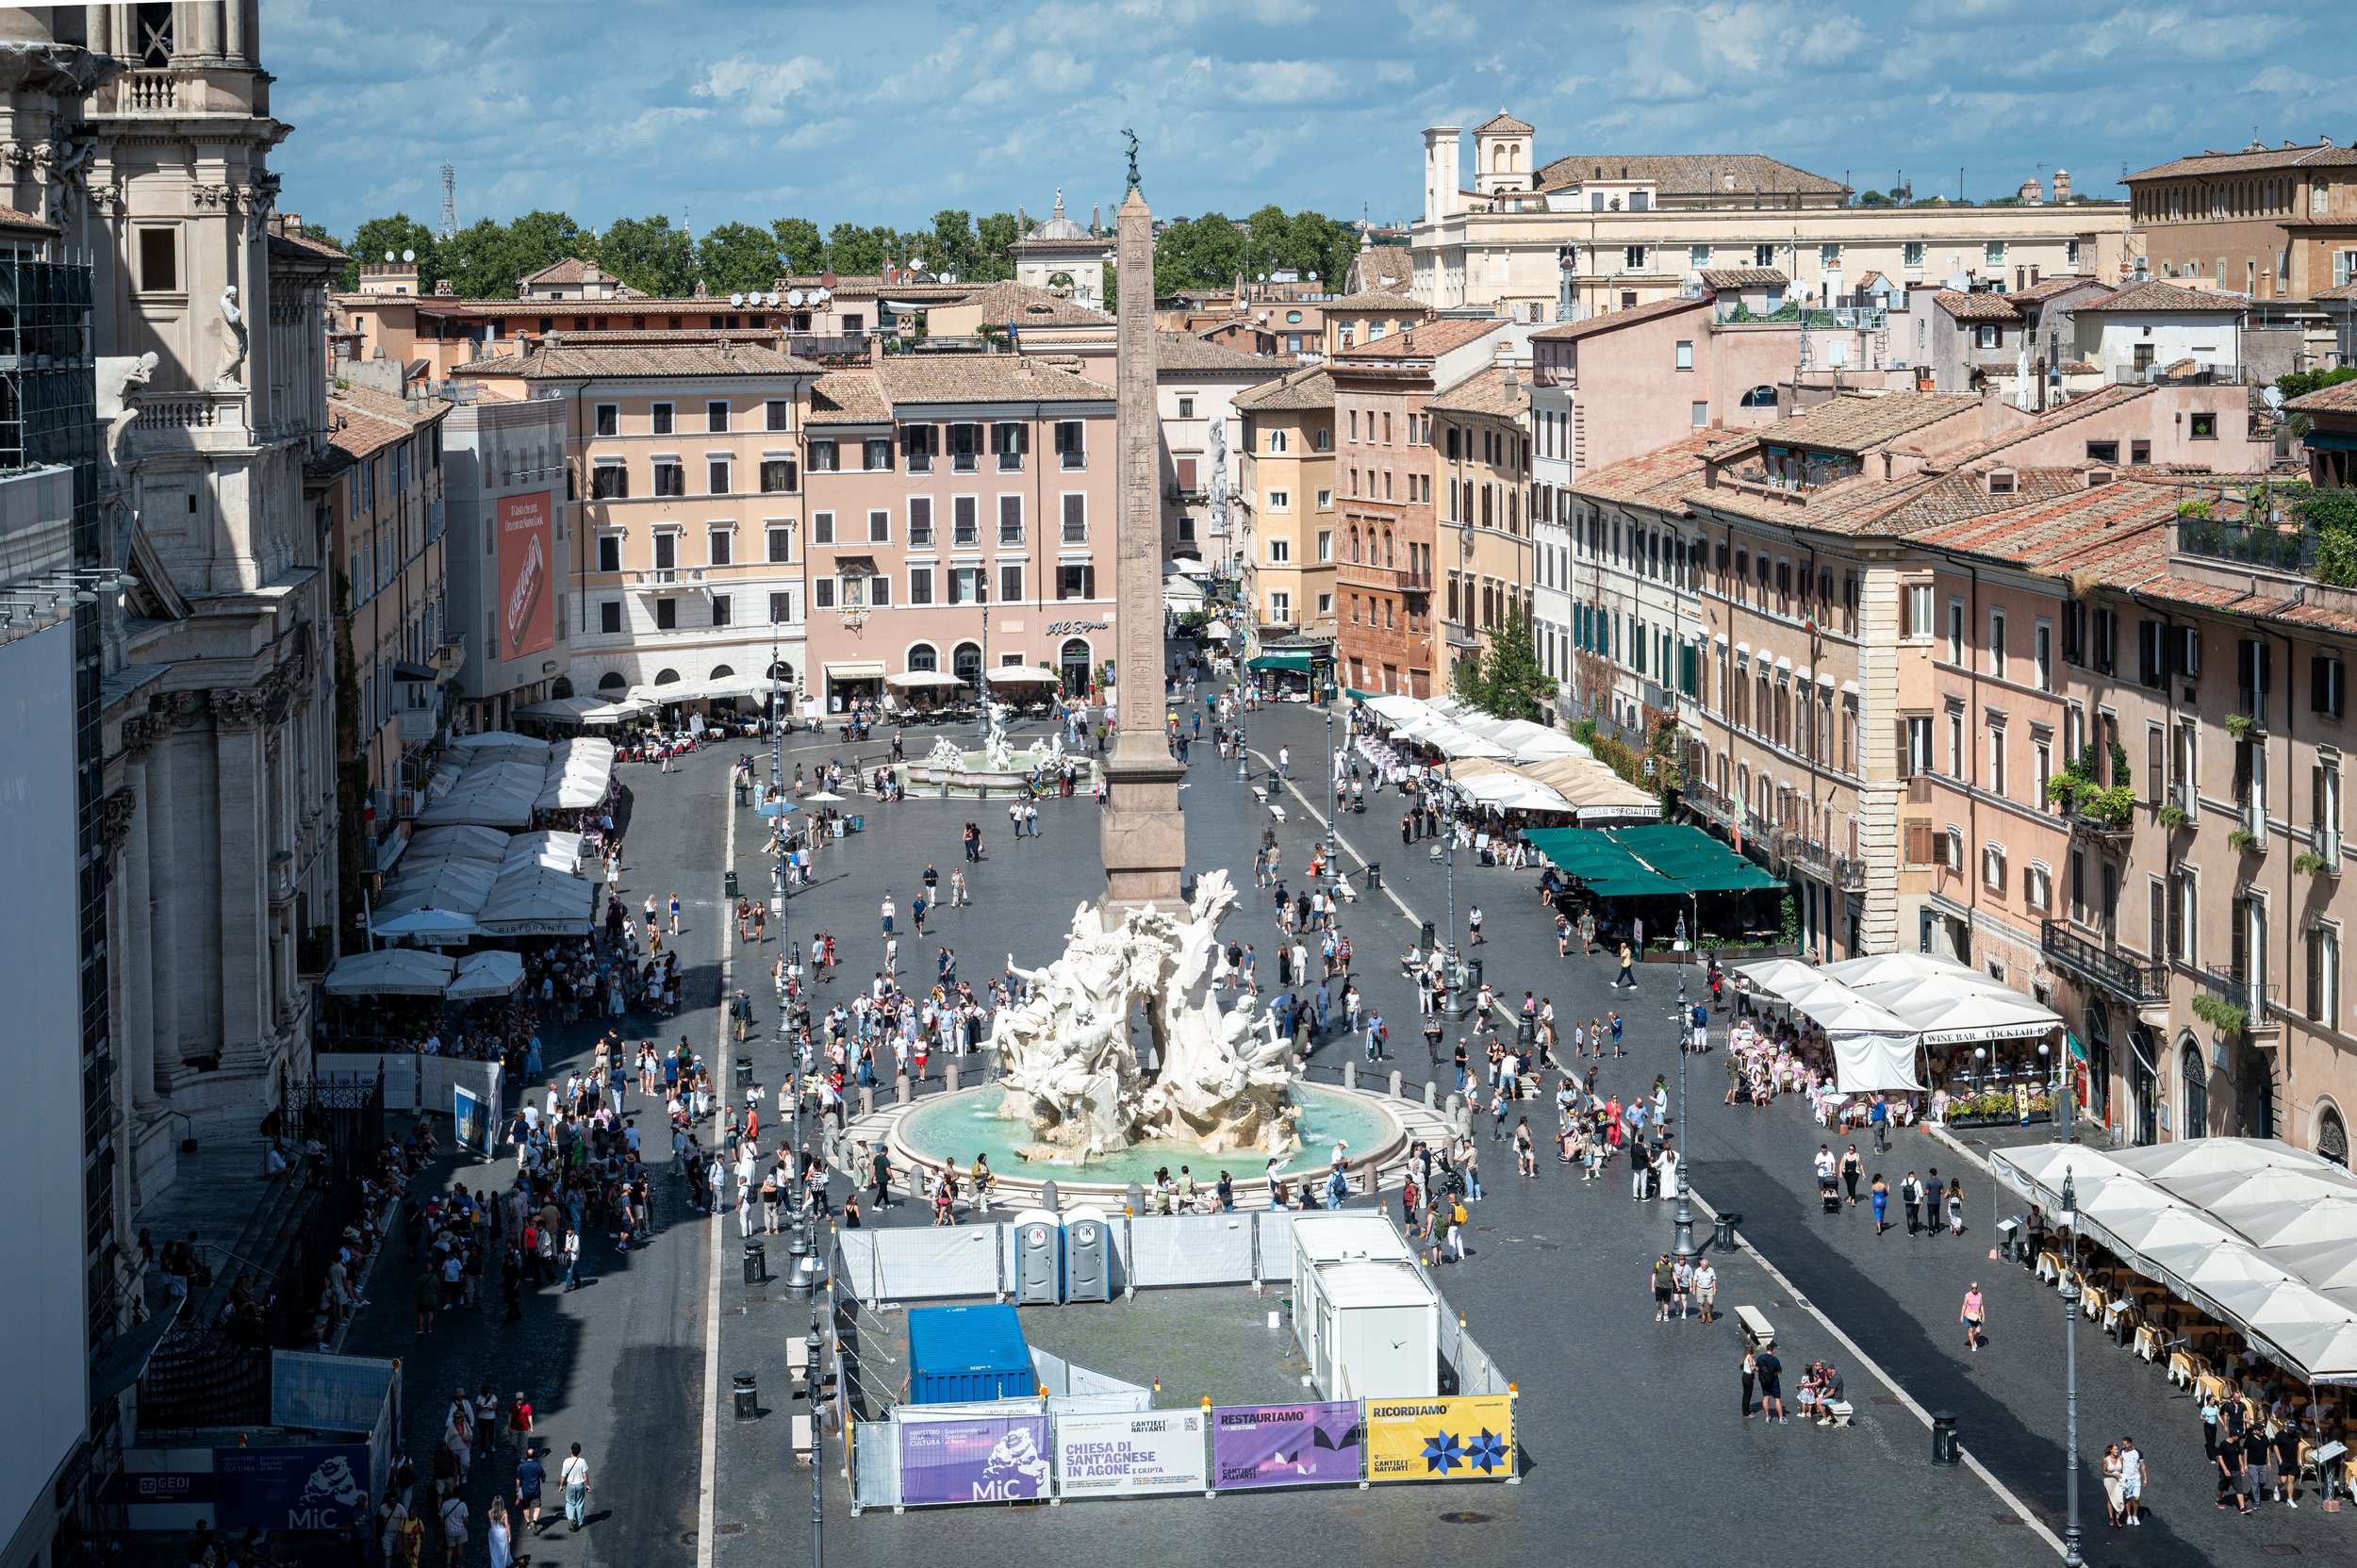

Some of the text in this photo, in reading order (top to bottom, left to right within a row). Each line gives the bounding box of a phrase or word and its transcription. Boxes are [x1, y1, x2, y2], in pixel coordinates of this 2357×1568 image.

[1072, 619, 1108, 635] Sogno
[499, 924, 569, 934] RISTORANTE
[458, 989, 497, 999] Ristorante
[1928, 1034, 1954, 1043] WINE
[1956, 1032, 1976, 1041] BAR
[1986, 1028, 2036, 1039] COCKTAIL
[2020, 1089, 2028, 1113] ATM
[1374, 1405, 1447, 1417] RICORDIAMO
[1221, 1411, 1304, 1425] RESTAURIAMO
[1066, 1441, 1132, 1454] CHIESA DI
[1066, 1452, 1156, 1465] SANT'AGNESE
[1067, 1466, 1081, 1477] IN
[1087, 1464, 1130, 1477] AGONE
[158, 1477, 190, 1488] GEDI
[972, 1479, 1021, 1501] MiC
[289, 1508, 338, 1529] MiC
